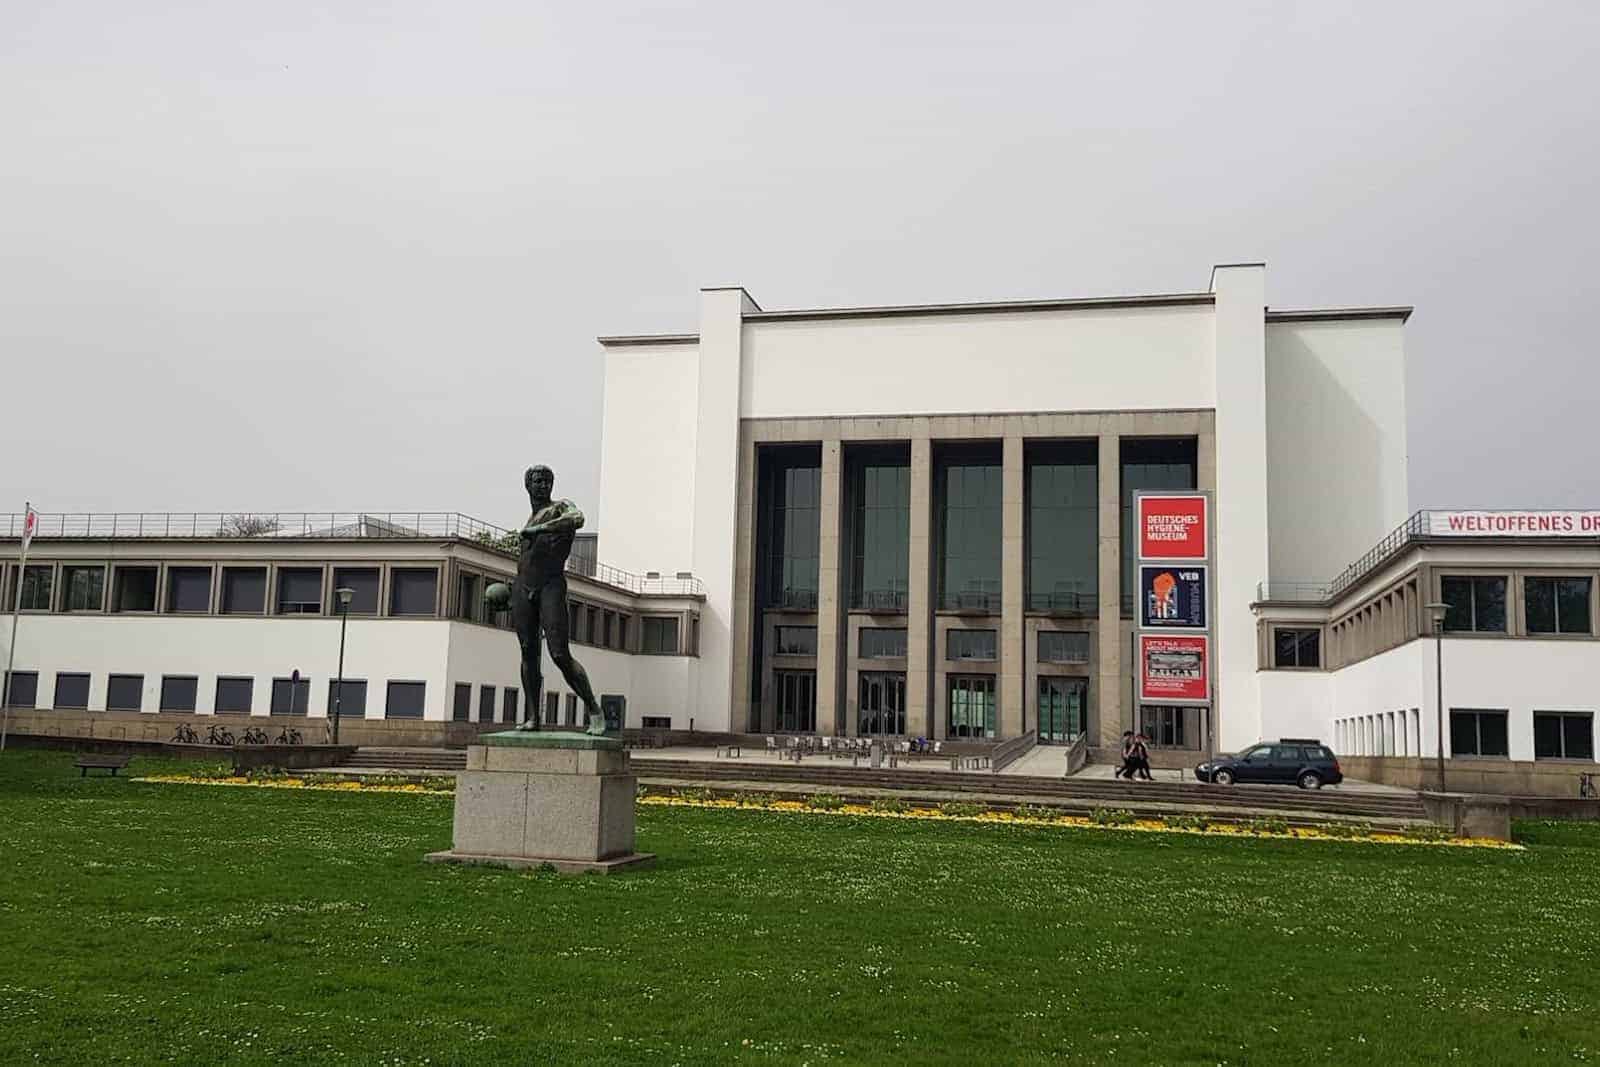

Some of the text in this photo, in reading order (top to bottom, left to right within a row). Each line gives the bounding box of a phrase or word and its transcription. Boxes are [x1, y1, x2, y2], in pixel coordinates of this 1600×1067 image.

[1147, 515, 1199, 524] DEUTSCHES
[1448, 515, 1573, 531] WELTOFFENES
[1147, 524, 1189, 532] HYGIENE-
[1147, 532, 1187, 541] MUSEUM
[1179, 572, 1199, 581] VEB
